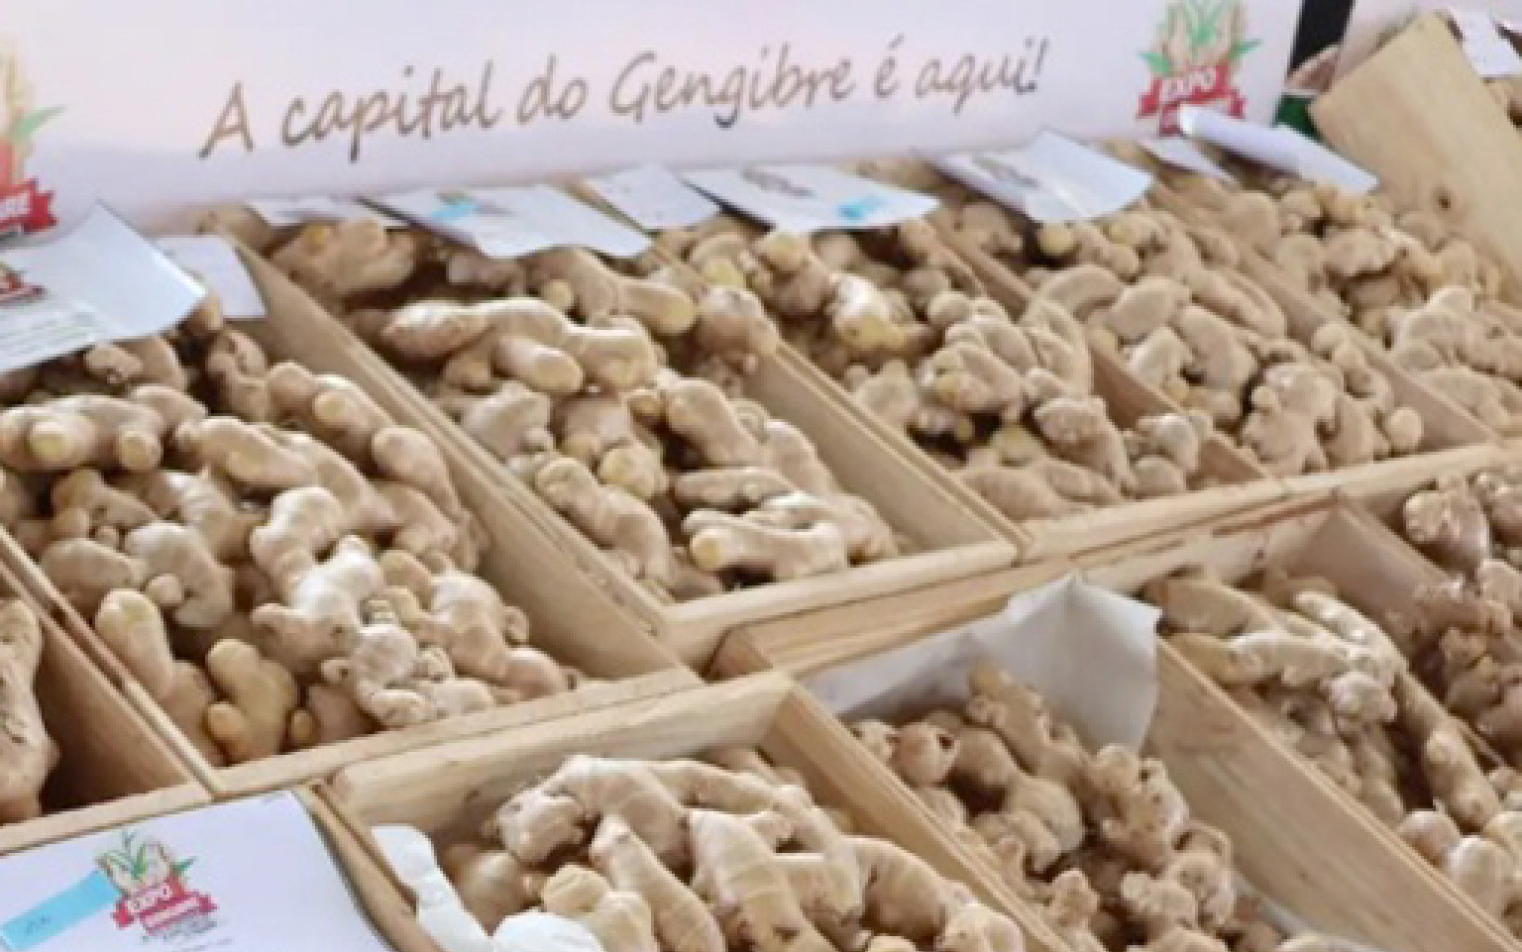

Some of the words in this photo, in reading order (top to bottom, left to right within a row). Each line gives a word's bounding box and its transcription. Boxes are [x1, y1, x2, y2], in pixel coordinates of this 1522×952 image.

[198, 80, 254, 159] A
[281, 60, 504, 164] capital
[516, 53, 588, 125] do
[609, 43, 856, 129] Gengibre
[876, 34, 904, 98] é
[915, 37, 1050, 116] aqui!
[127, 882, 172, 913] EXPO
